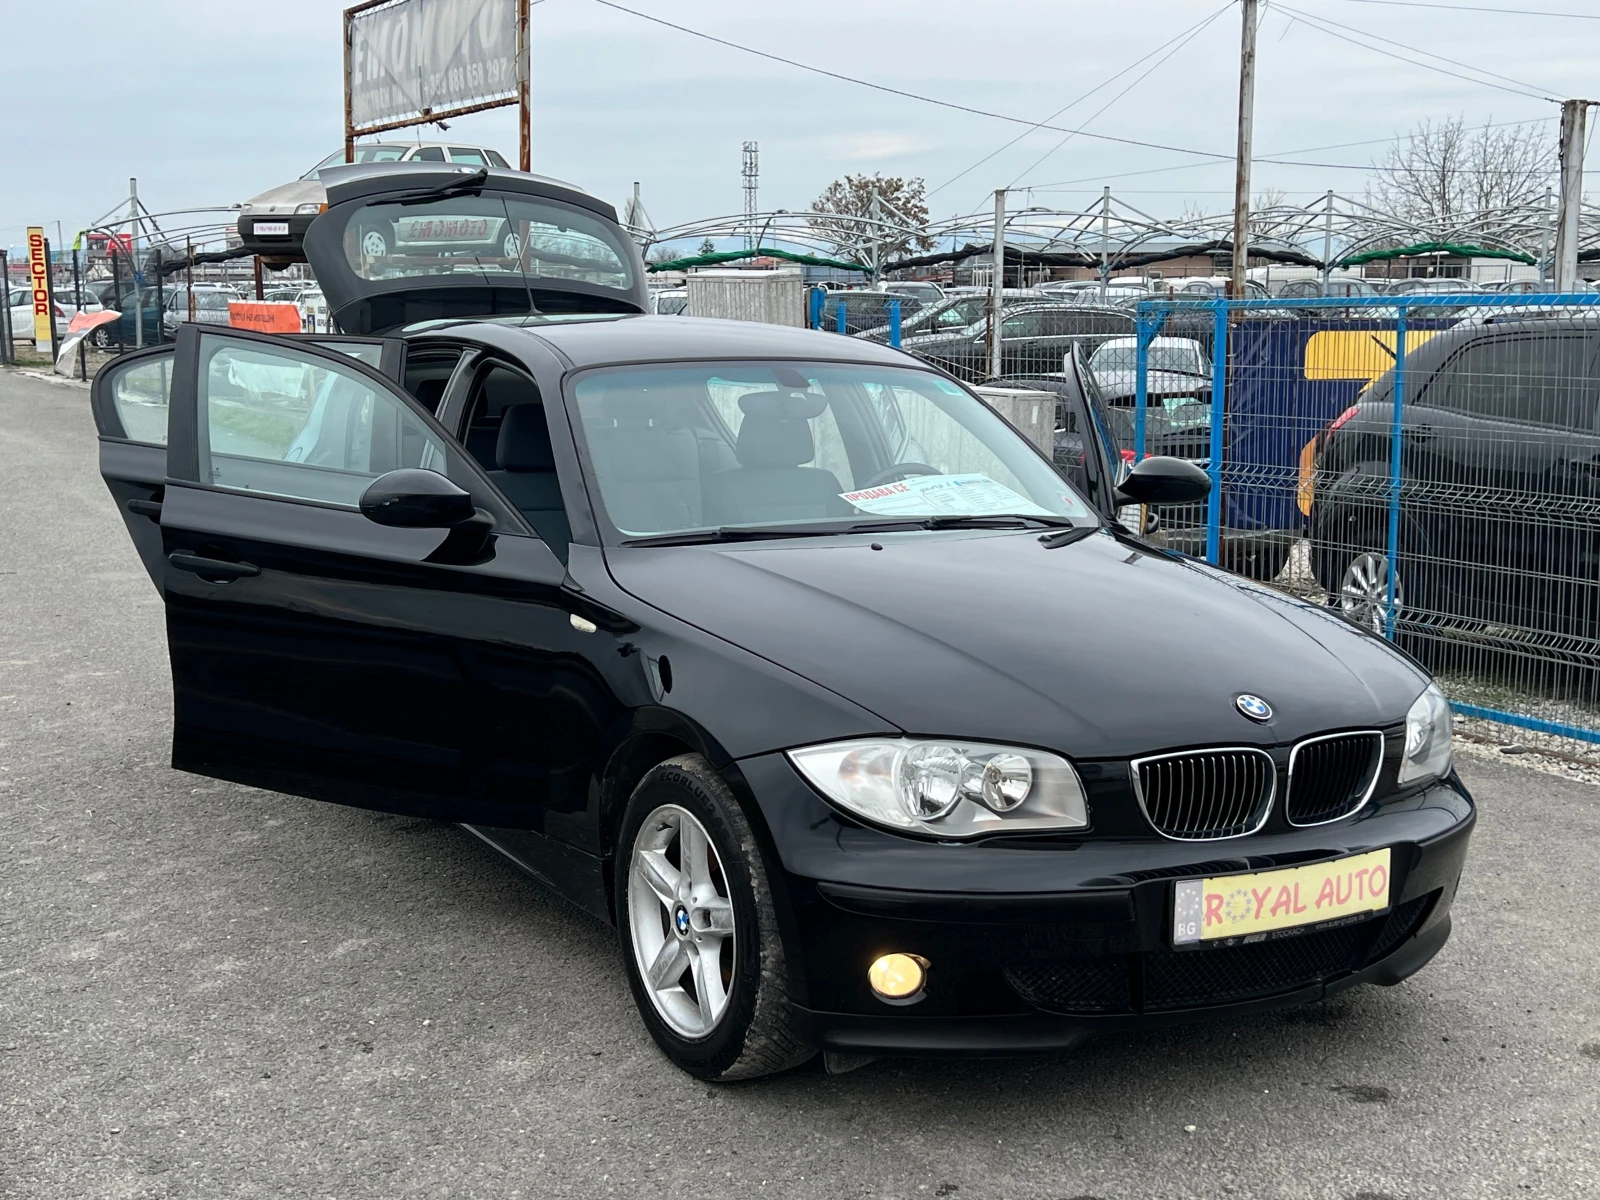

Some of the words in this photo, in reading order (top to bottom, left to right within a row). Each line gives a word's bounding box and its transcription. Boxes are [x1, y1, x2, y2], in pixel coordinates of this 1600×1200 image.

[424, 73, 447, 96] +359
[448, 68, 465, 92] 888
[467, 61, 484, 88] 658
[486, 57, 508, 84] 297
[29, 234, 49, 316] SECTOR
[844, 486, 896, 502] ПРОДАВА
[892, 482, 911, 494] СЕ
[1314, 865, 1388, 910] AUTO
[1177, 921, 1197, 937] BG
[1271, 927, 1306, 940] STOCKACH
